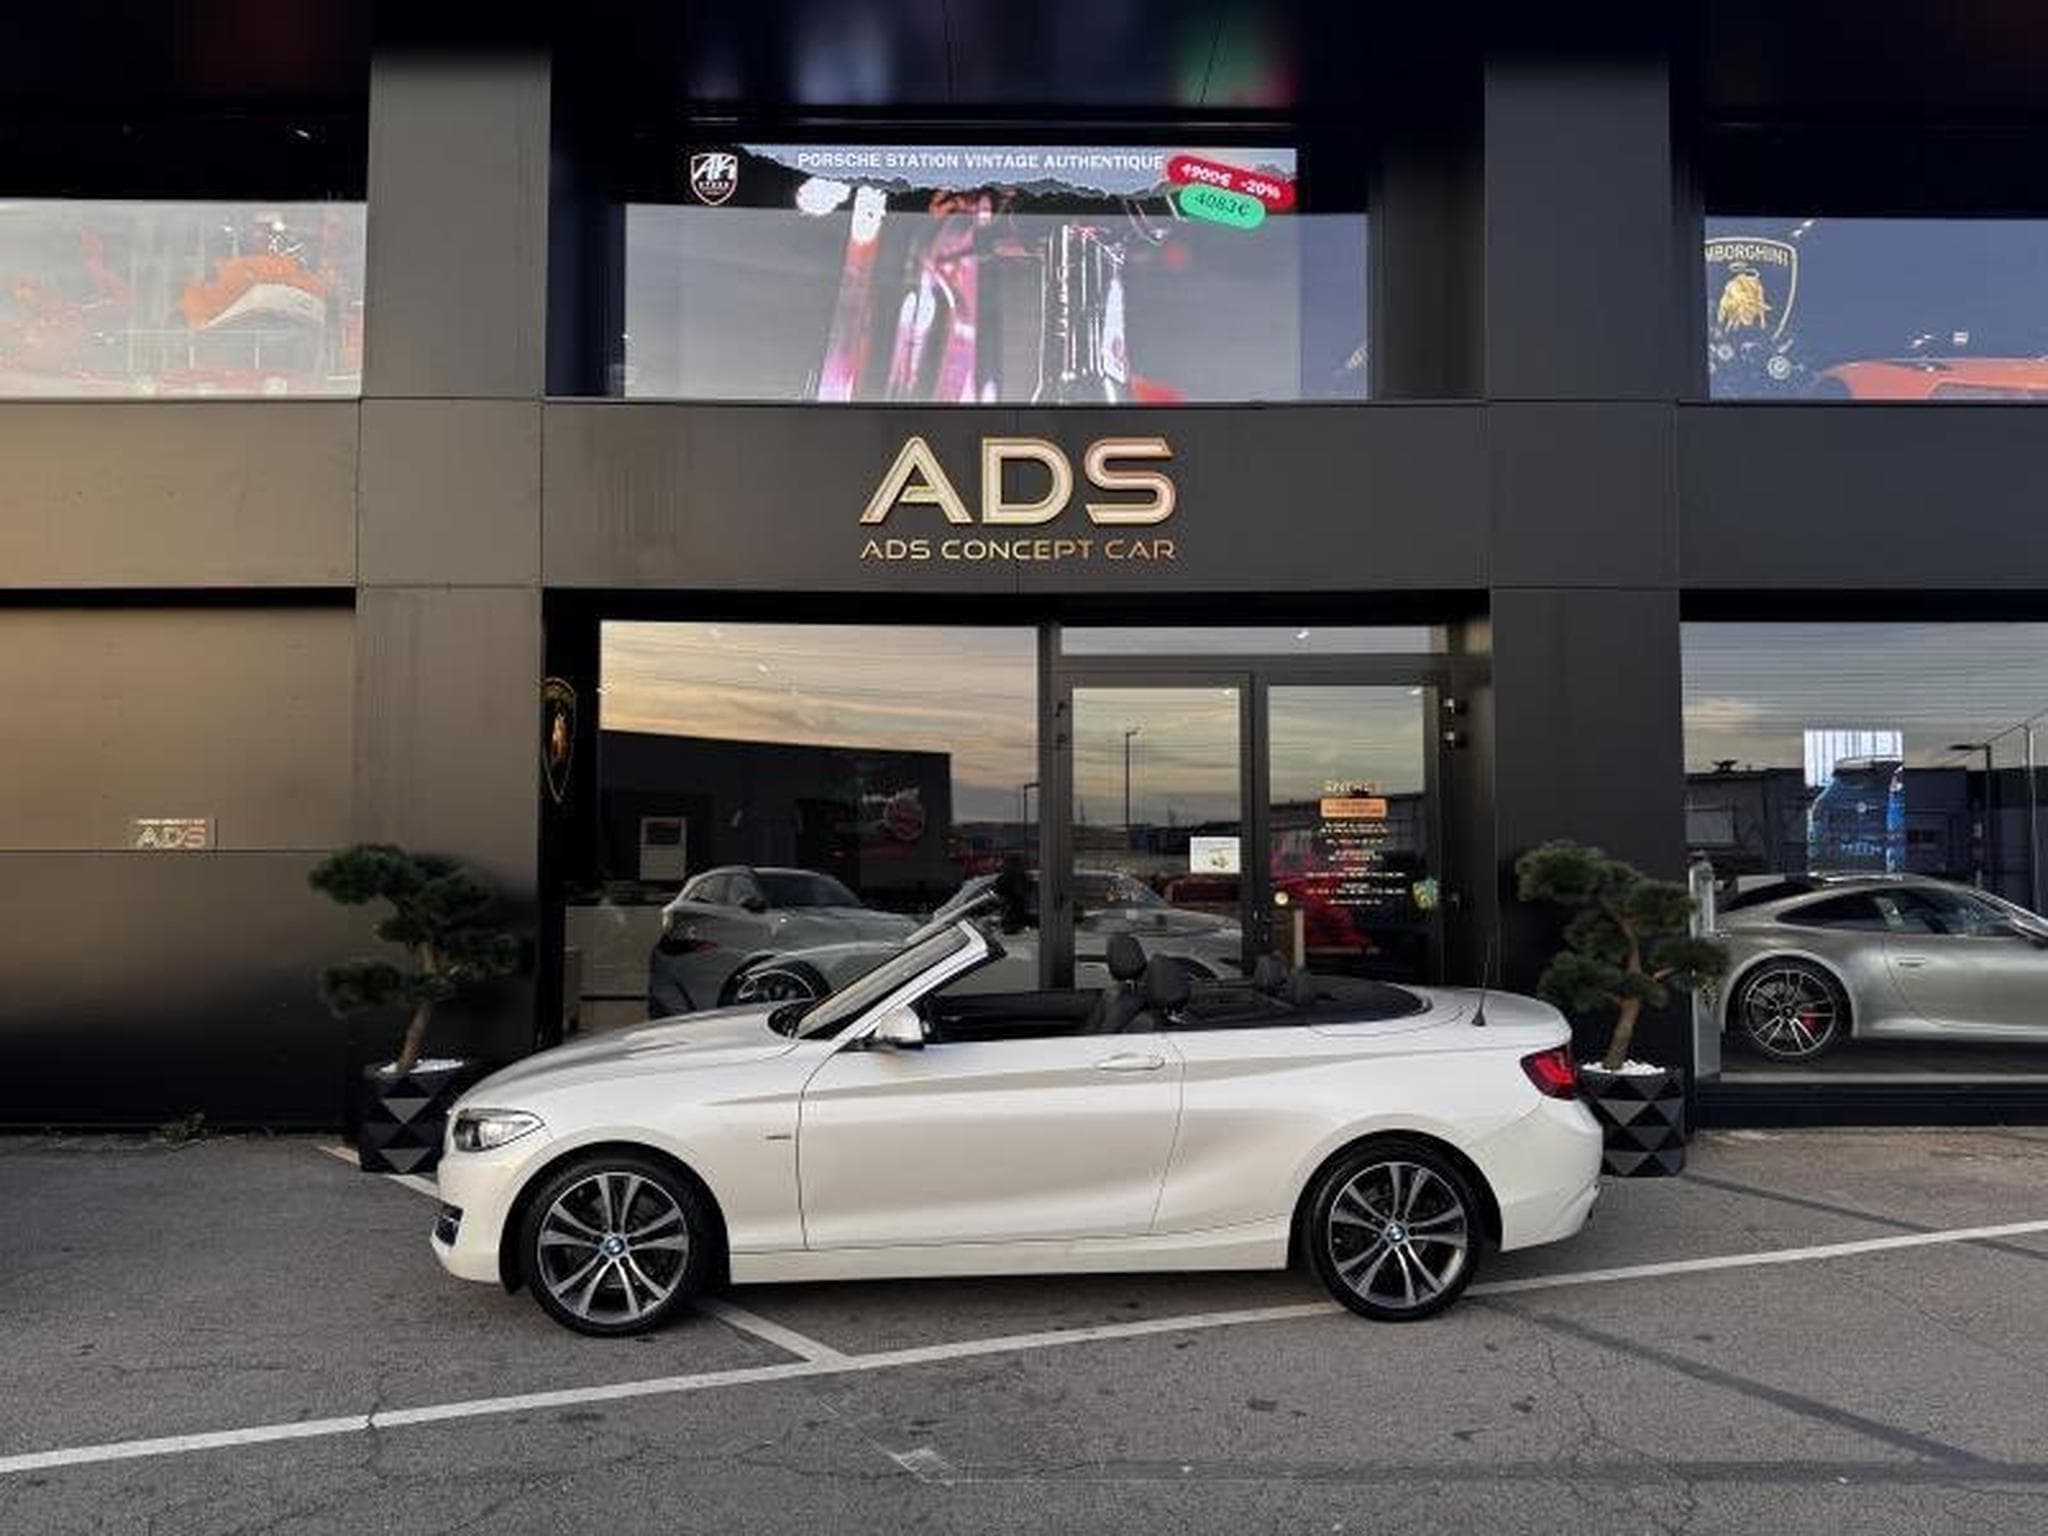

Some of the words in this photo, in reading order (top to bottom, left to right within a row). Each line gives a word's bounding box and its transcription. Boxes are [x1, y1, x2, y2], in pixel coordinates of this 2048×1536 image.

[797, 153, 881, 169] PORSCHE
[885, 153, 959, 170] STATION
[964, 153, 1038, 169] VINTAGE
[1042, 154, 1164, 172] AUTHENTIQUE
[859, 436, 1178, 526] ADS
[859, 539, 931, 560] ADS
[940, 539, 1092, 560] CONCEPT
[1104, 539, 1177, 560] CAR
